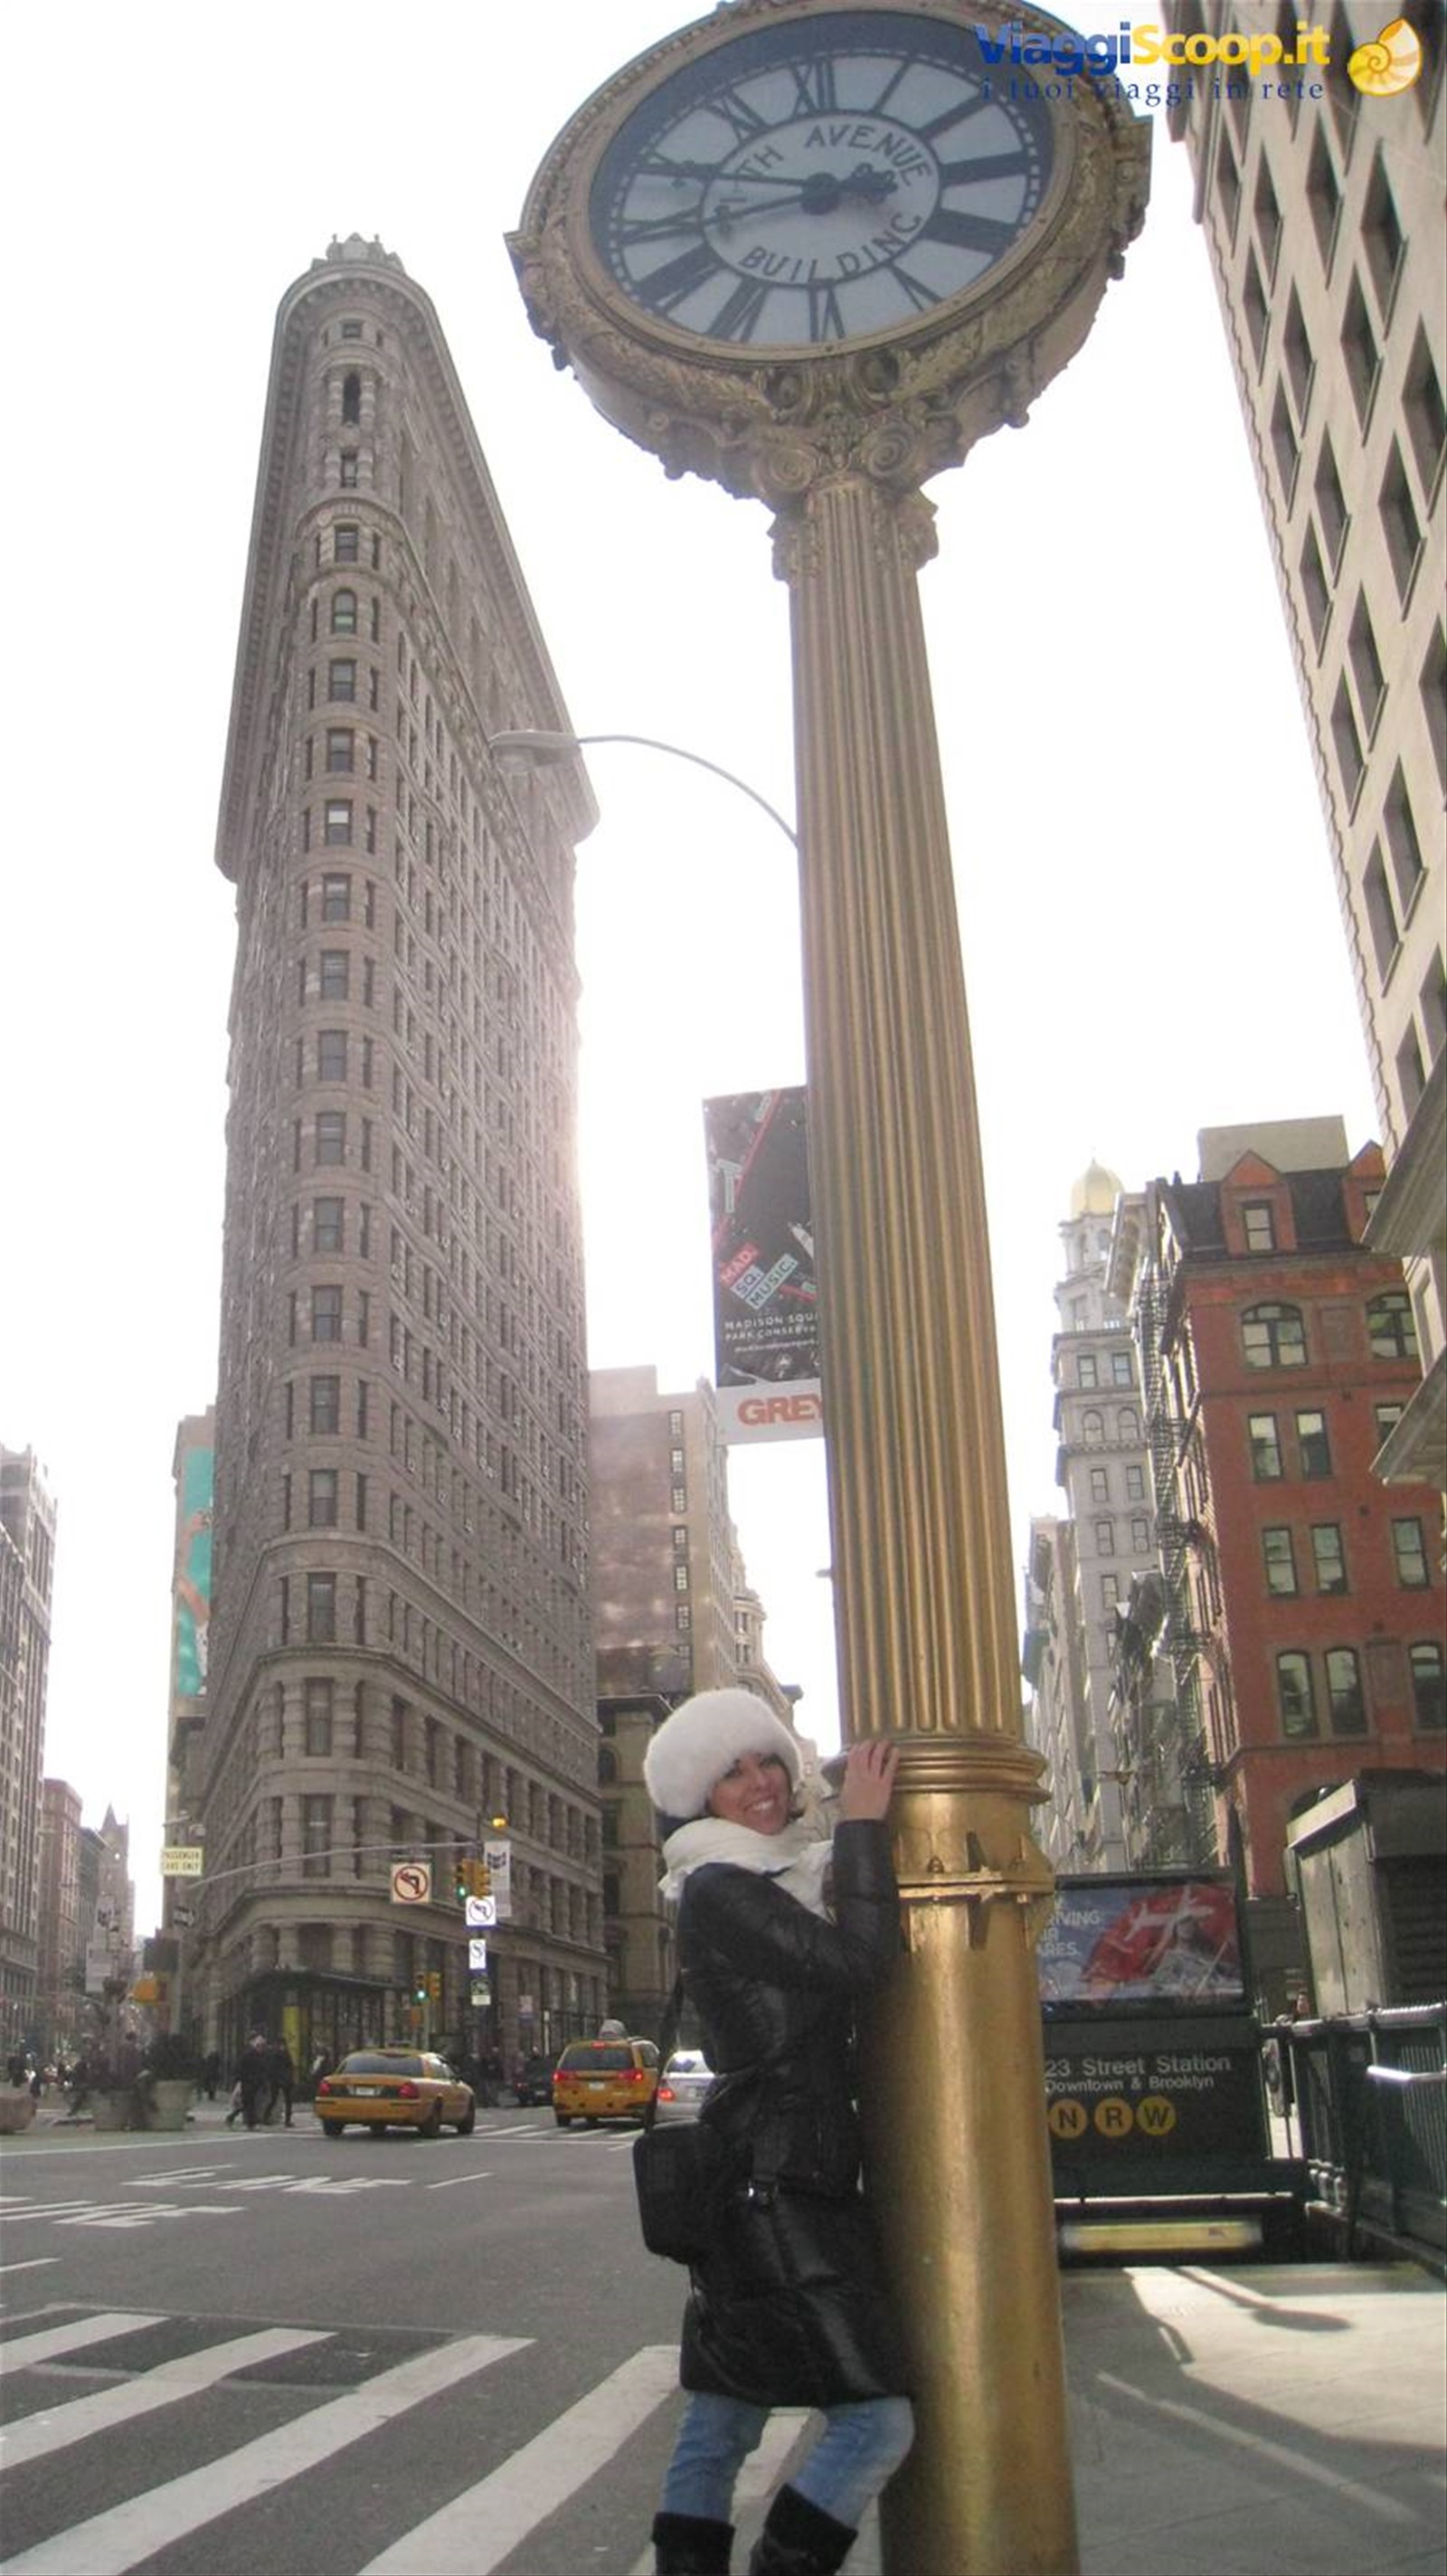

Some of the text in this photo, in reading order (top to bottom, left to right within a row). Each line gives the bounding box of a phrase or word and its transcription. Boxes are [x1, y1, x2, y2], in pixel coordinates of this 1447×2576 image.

[803, 123, 932, 187] AVENUE
[724, 1316, 784, 1331] MADISON
[1045, 2054, 1232, 2078] 23 Street Station
[1045, 2075, 1215, 2095] Downtown & Brooklyn
[1058, 2105, 1169, 2129] N R W
